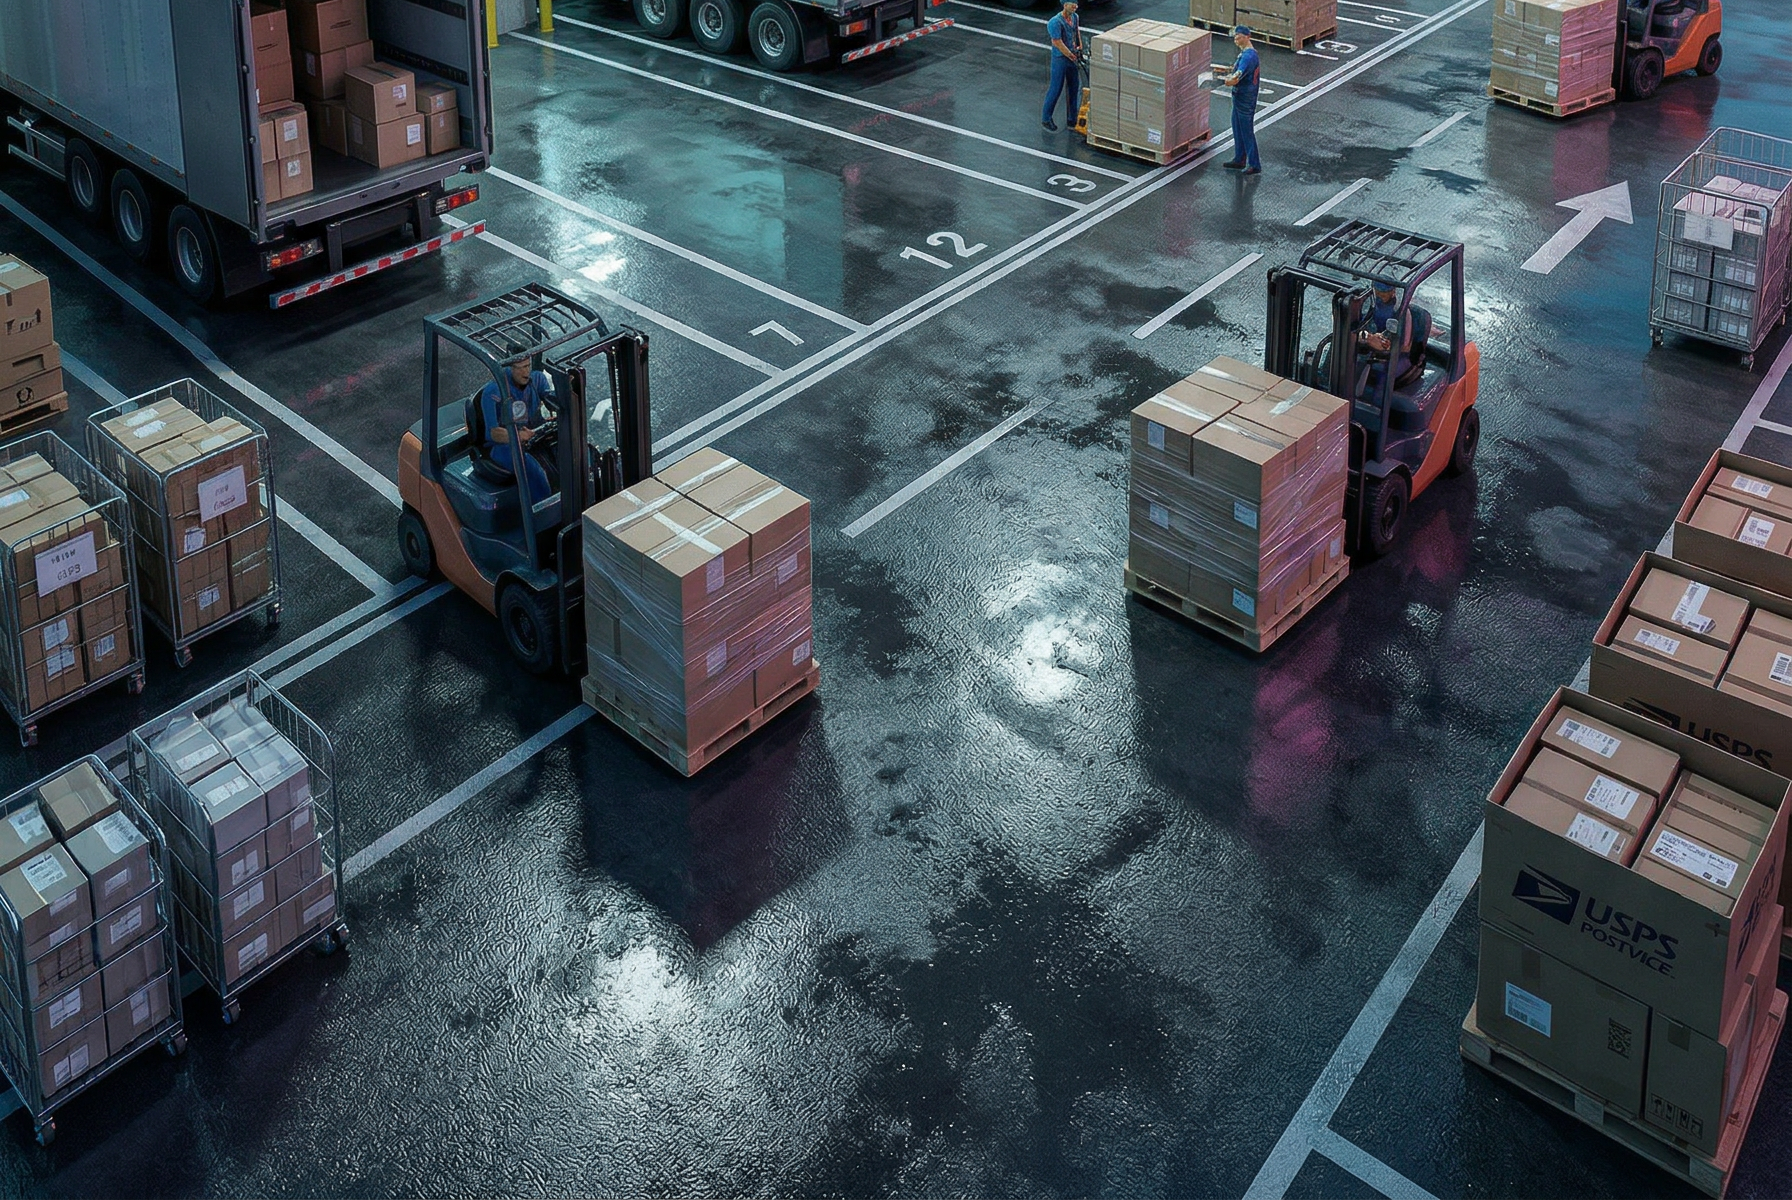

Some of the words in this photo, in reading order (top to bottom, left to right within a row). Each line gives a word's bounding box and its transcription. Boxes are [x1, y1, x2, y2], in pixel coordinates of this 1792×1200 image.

[1046, 173, 1097, 194] 3
[900, 231, 987, 269] 12
[1585, 896, 1679, 960] USPS
